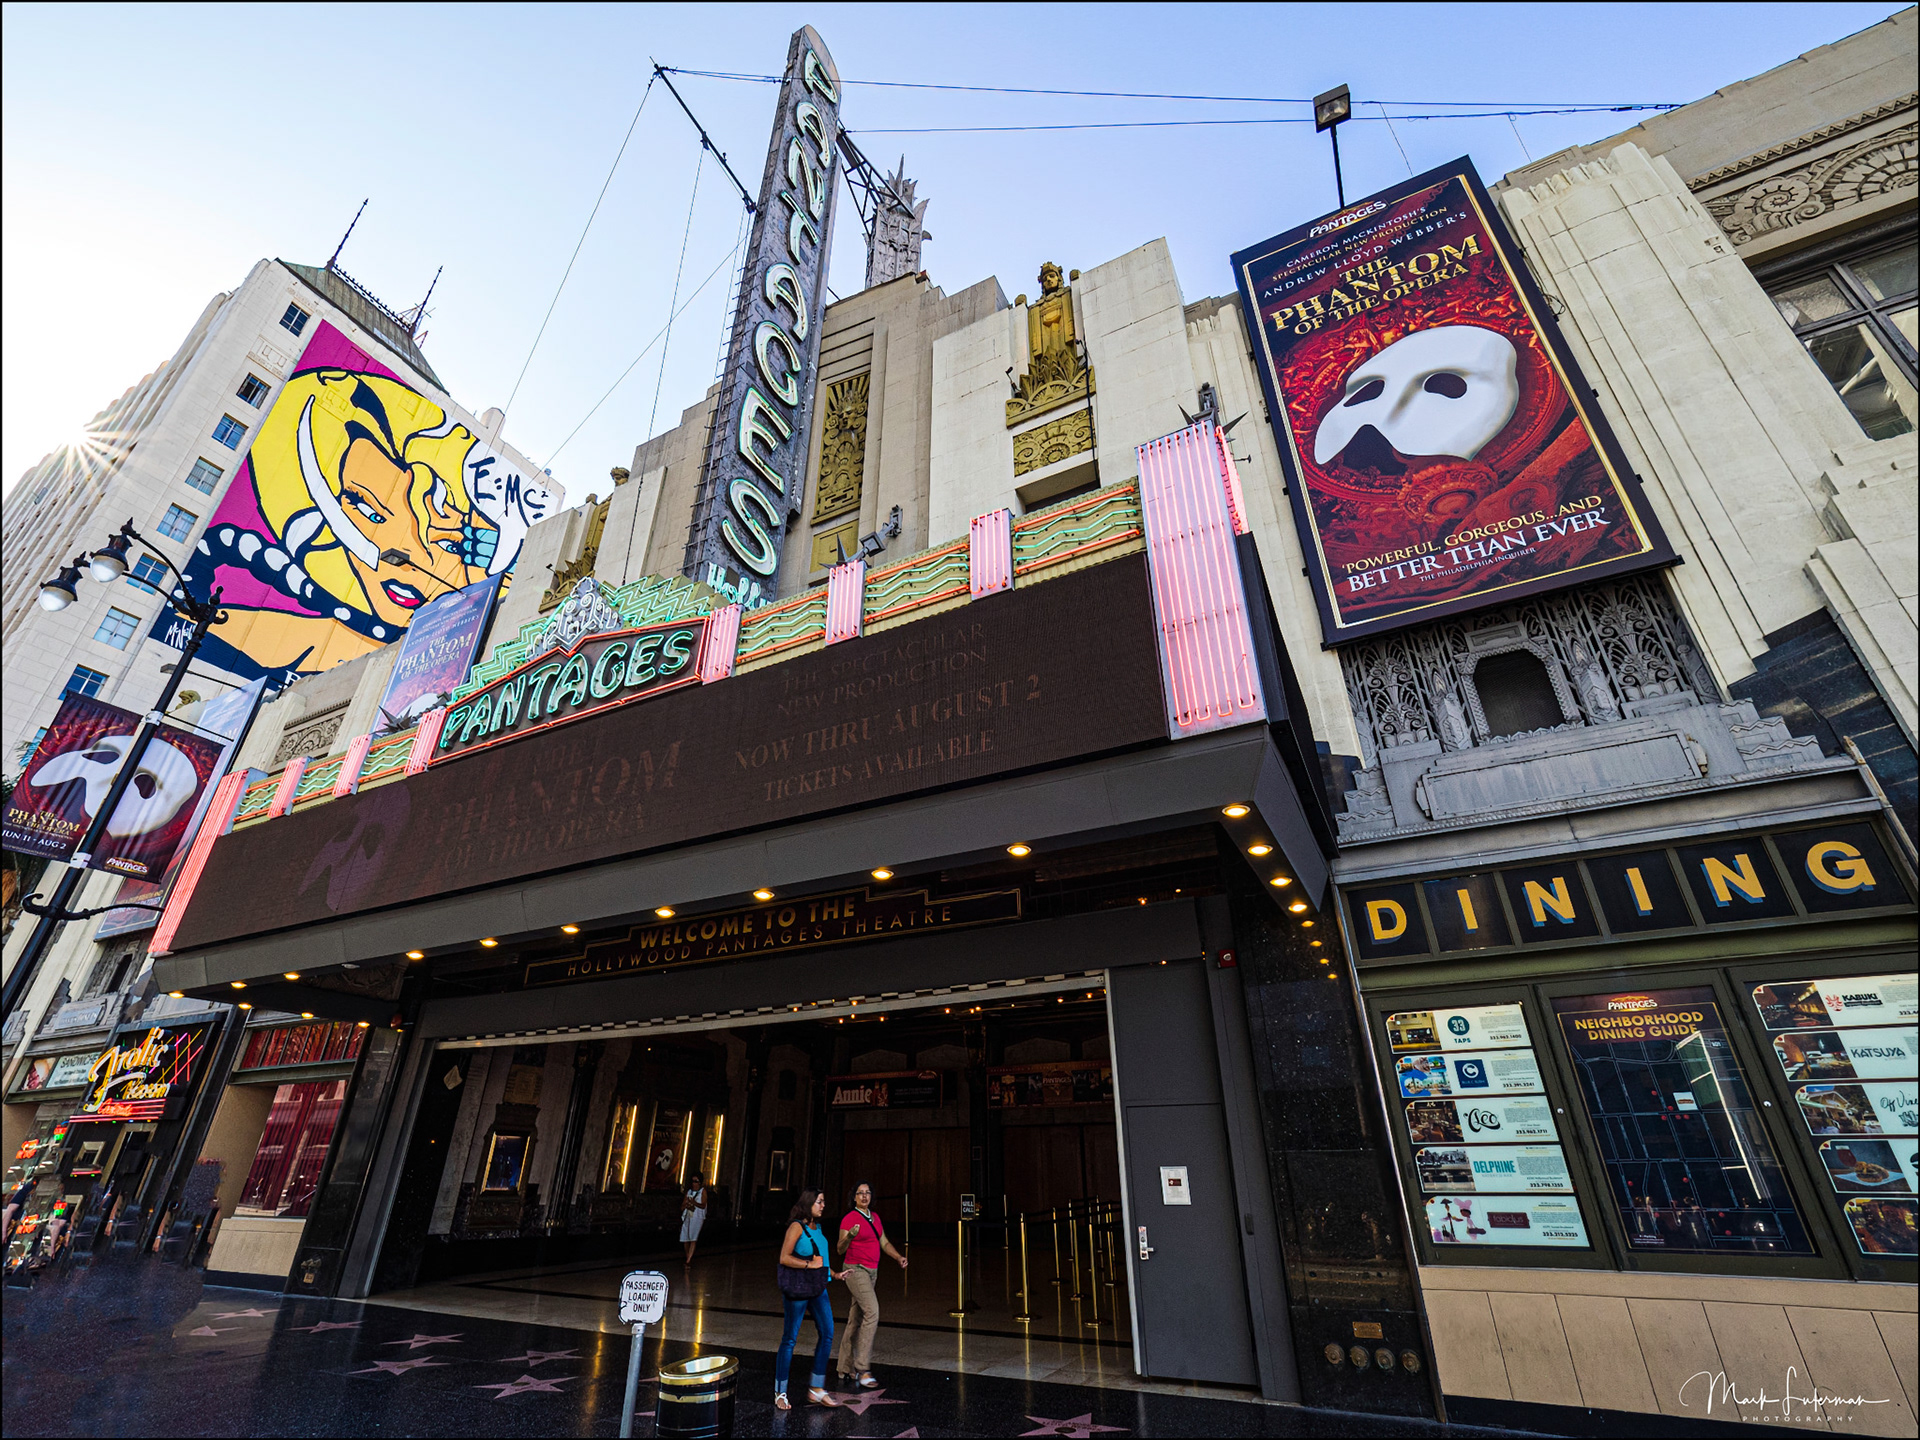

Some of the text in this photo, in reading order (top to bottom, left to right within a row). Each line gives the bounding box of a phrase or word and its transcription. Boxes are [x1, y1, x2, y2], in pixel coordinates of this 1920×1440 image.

[1309, 200, 1387, 238] PANTAGES
[1272, 206, 1448, 281] SPECTACULAR NEW PRODUCTION
[1286, 206, 1427, 268] CAMERON MACKINTOSH'S
[1354, 246, 1363, 254] OF
[1264, 211, 1467, 298] ANDREW LLOYD WEBBER'S
[1269, 234, 1484, 332] PHANTOM
[1339, 255, 1393, 284] THE
[721, 47, 838, 578] PANTAGES
[1294, 263, 1469, 335] OF THE OPERA
[1347, 554, 1445, 593] BETTER
[1444, 530, 1527, 566] THAN
[1420, 547, 1536, 582] THE PHILADELPHIA INQUIRER
[399, 632, 474, 674] PHANTOM
[429, 635, 448, 649] THE
[831, 623, 985, 676] SPECTACULAR
[401, 651, 461, 680] OF THE OPERA
[440, 630, 694, 749] PANTAGES
[777, 645, 988, 717] NEW PRODUCTION
[734, 673, 1042, 773] NOW THRU AUGUST 2
[764, 729, 995, 802] TICKETS AVAILABLE
[436, 740, 682, 846] PHANTOM
[8, 807, 80, 832] PHANTOM
[43, 825, 70, 836] OPERA
[38, 838, 60, 848] AUG
[106, 857, 148, 873] PANTAGES
[1365, 839, 1878, 945] DINING
[640, 896, 855, 949] WELCOME TO THE
[568, 906, 953, 977] HOLLYWOOD PANTAGES THEATRE
[1608, 999, 1658, 1010] PANTAGES
[1842, 993, 1878, 1001] KABUKI
[1451, 1019, 1466, 1032] 33
[1574, 1012, 1704, 1030] NEIGHBORHOOD
[1588, 1023, 1698, 1040] DINING GUIDE
[60, 1054, 99, 1068] SANDWICHE
[1851, 1047, 1905, 1058] KATSUYA
[84, 1026, 169, 1112] Frolic
[121, 1079, 170, 1099] Room
[832, 1085, 873, 1105] Annie
[1473, 1160, 1516, 1173] DELPHINE
[625, 1281, 664, 1291] PASSENGER
[628, 1292, 659, 1302] LOADING
[633, 1303, 651, 1313] ONLY
